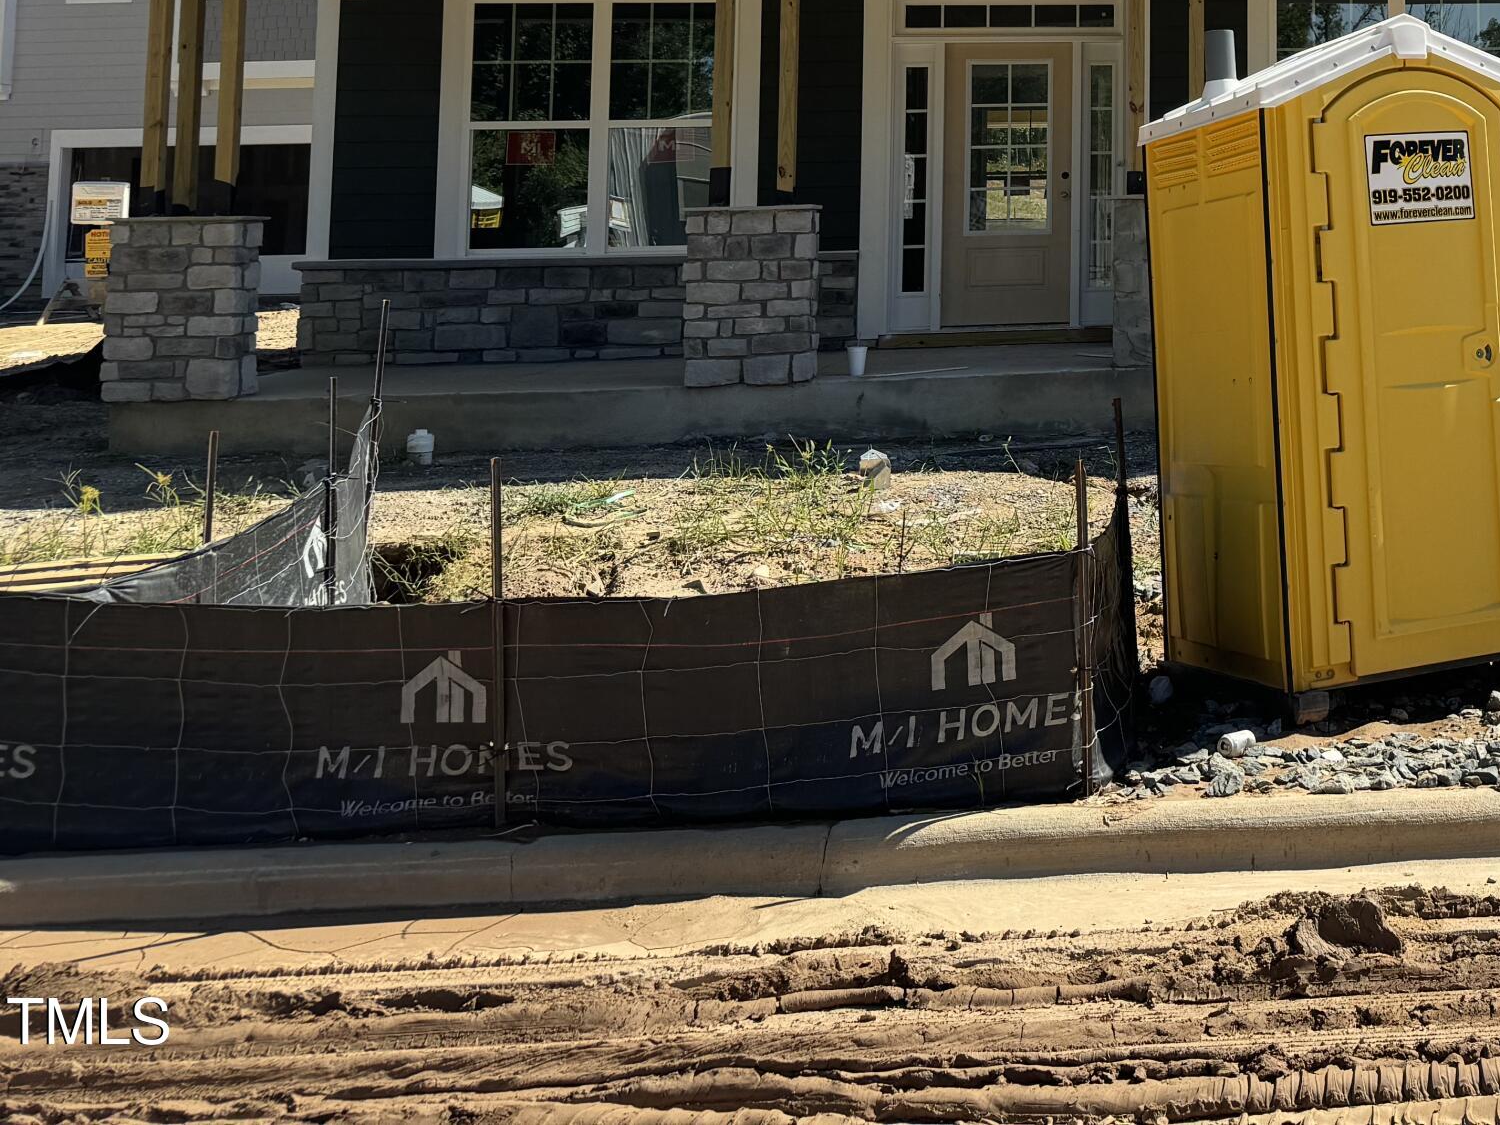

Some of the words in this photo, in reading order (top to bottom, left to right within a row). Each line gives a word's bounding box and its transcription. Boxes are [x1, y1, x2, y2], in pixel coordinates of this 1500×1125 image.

[1371, 138, 1465, 175] FOREVER
[1402, 153, 1467, 185] Clean
[1372, 185, 1470, 205] 919-552-0200
[1374, 205, 1472, 221] www.foreverclean.com
[878, 761, 969, 790] Welcome
[974, 756, 994, 775] to
[997, 748, 1059, 771] Better
[339, 792, 438, 820] Welcome
[442, 792, 467, 809] to
[470, 788, 536, 808] Beter
